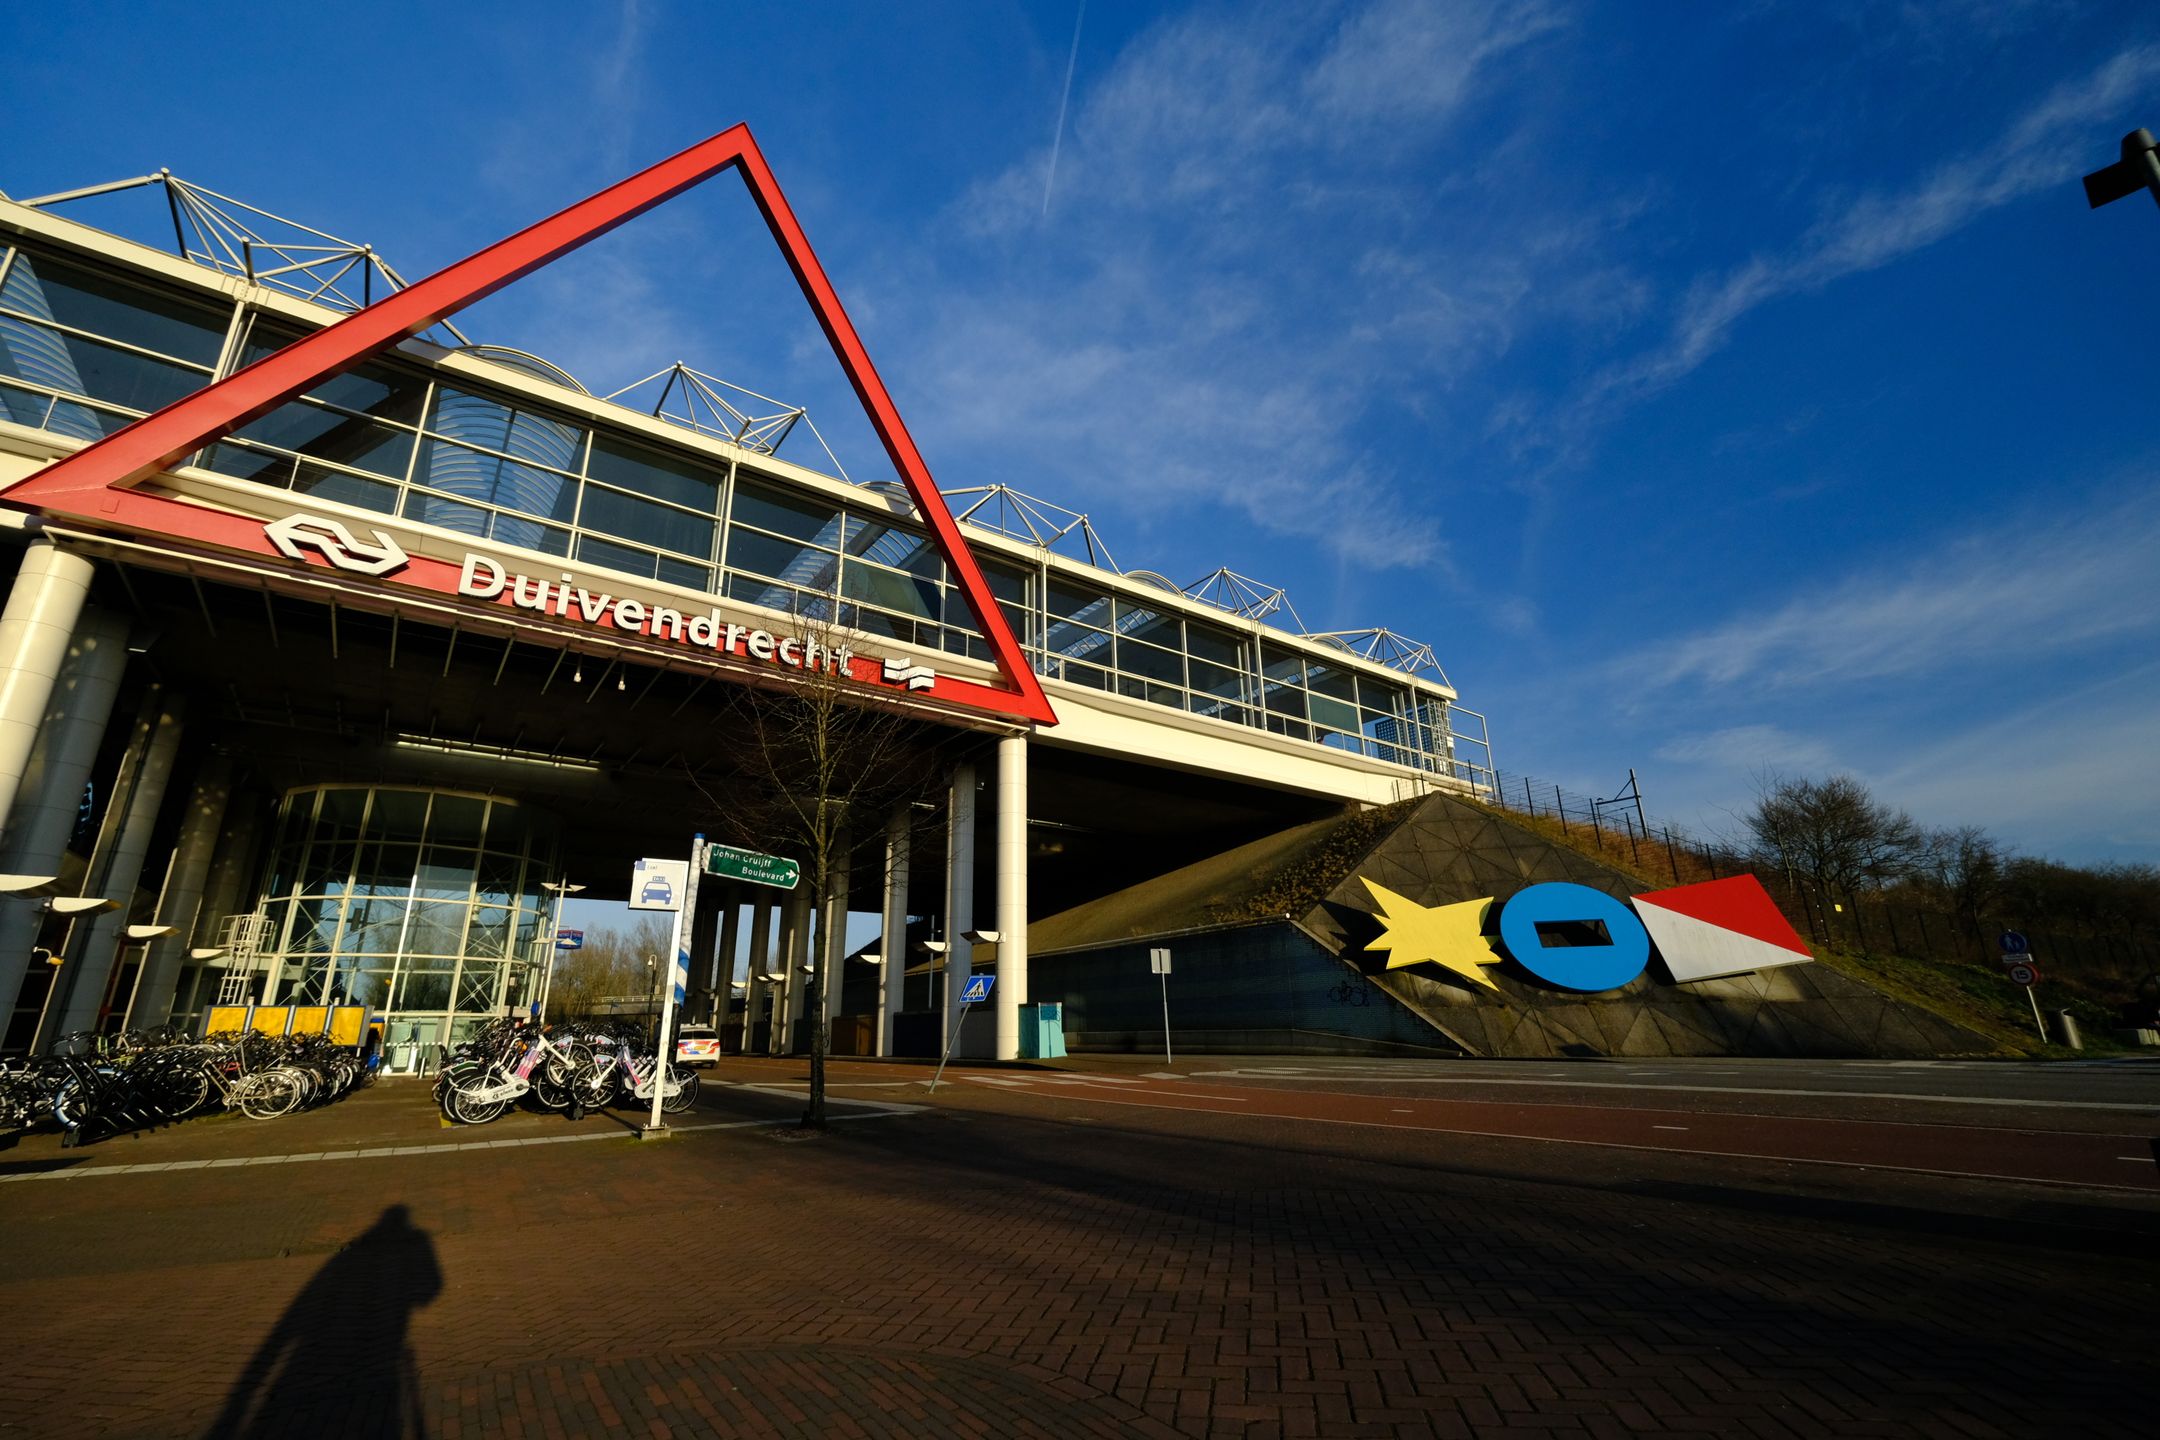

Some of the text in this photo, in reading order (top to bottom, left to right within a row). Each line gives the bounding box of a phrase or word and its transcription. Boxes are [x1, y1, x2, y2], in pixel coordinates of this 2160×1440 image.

[458, 553, 854, 677] Duivendrecht
[713, 849, 771, 868] Johan Cruijff
[742, 866, 785, 882] Boulevard
[2014, 969, 2029, 980] 15
